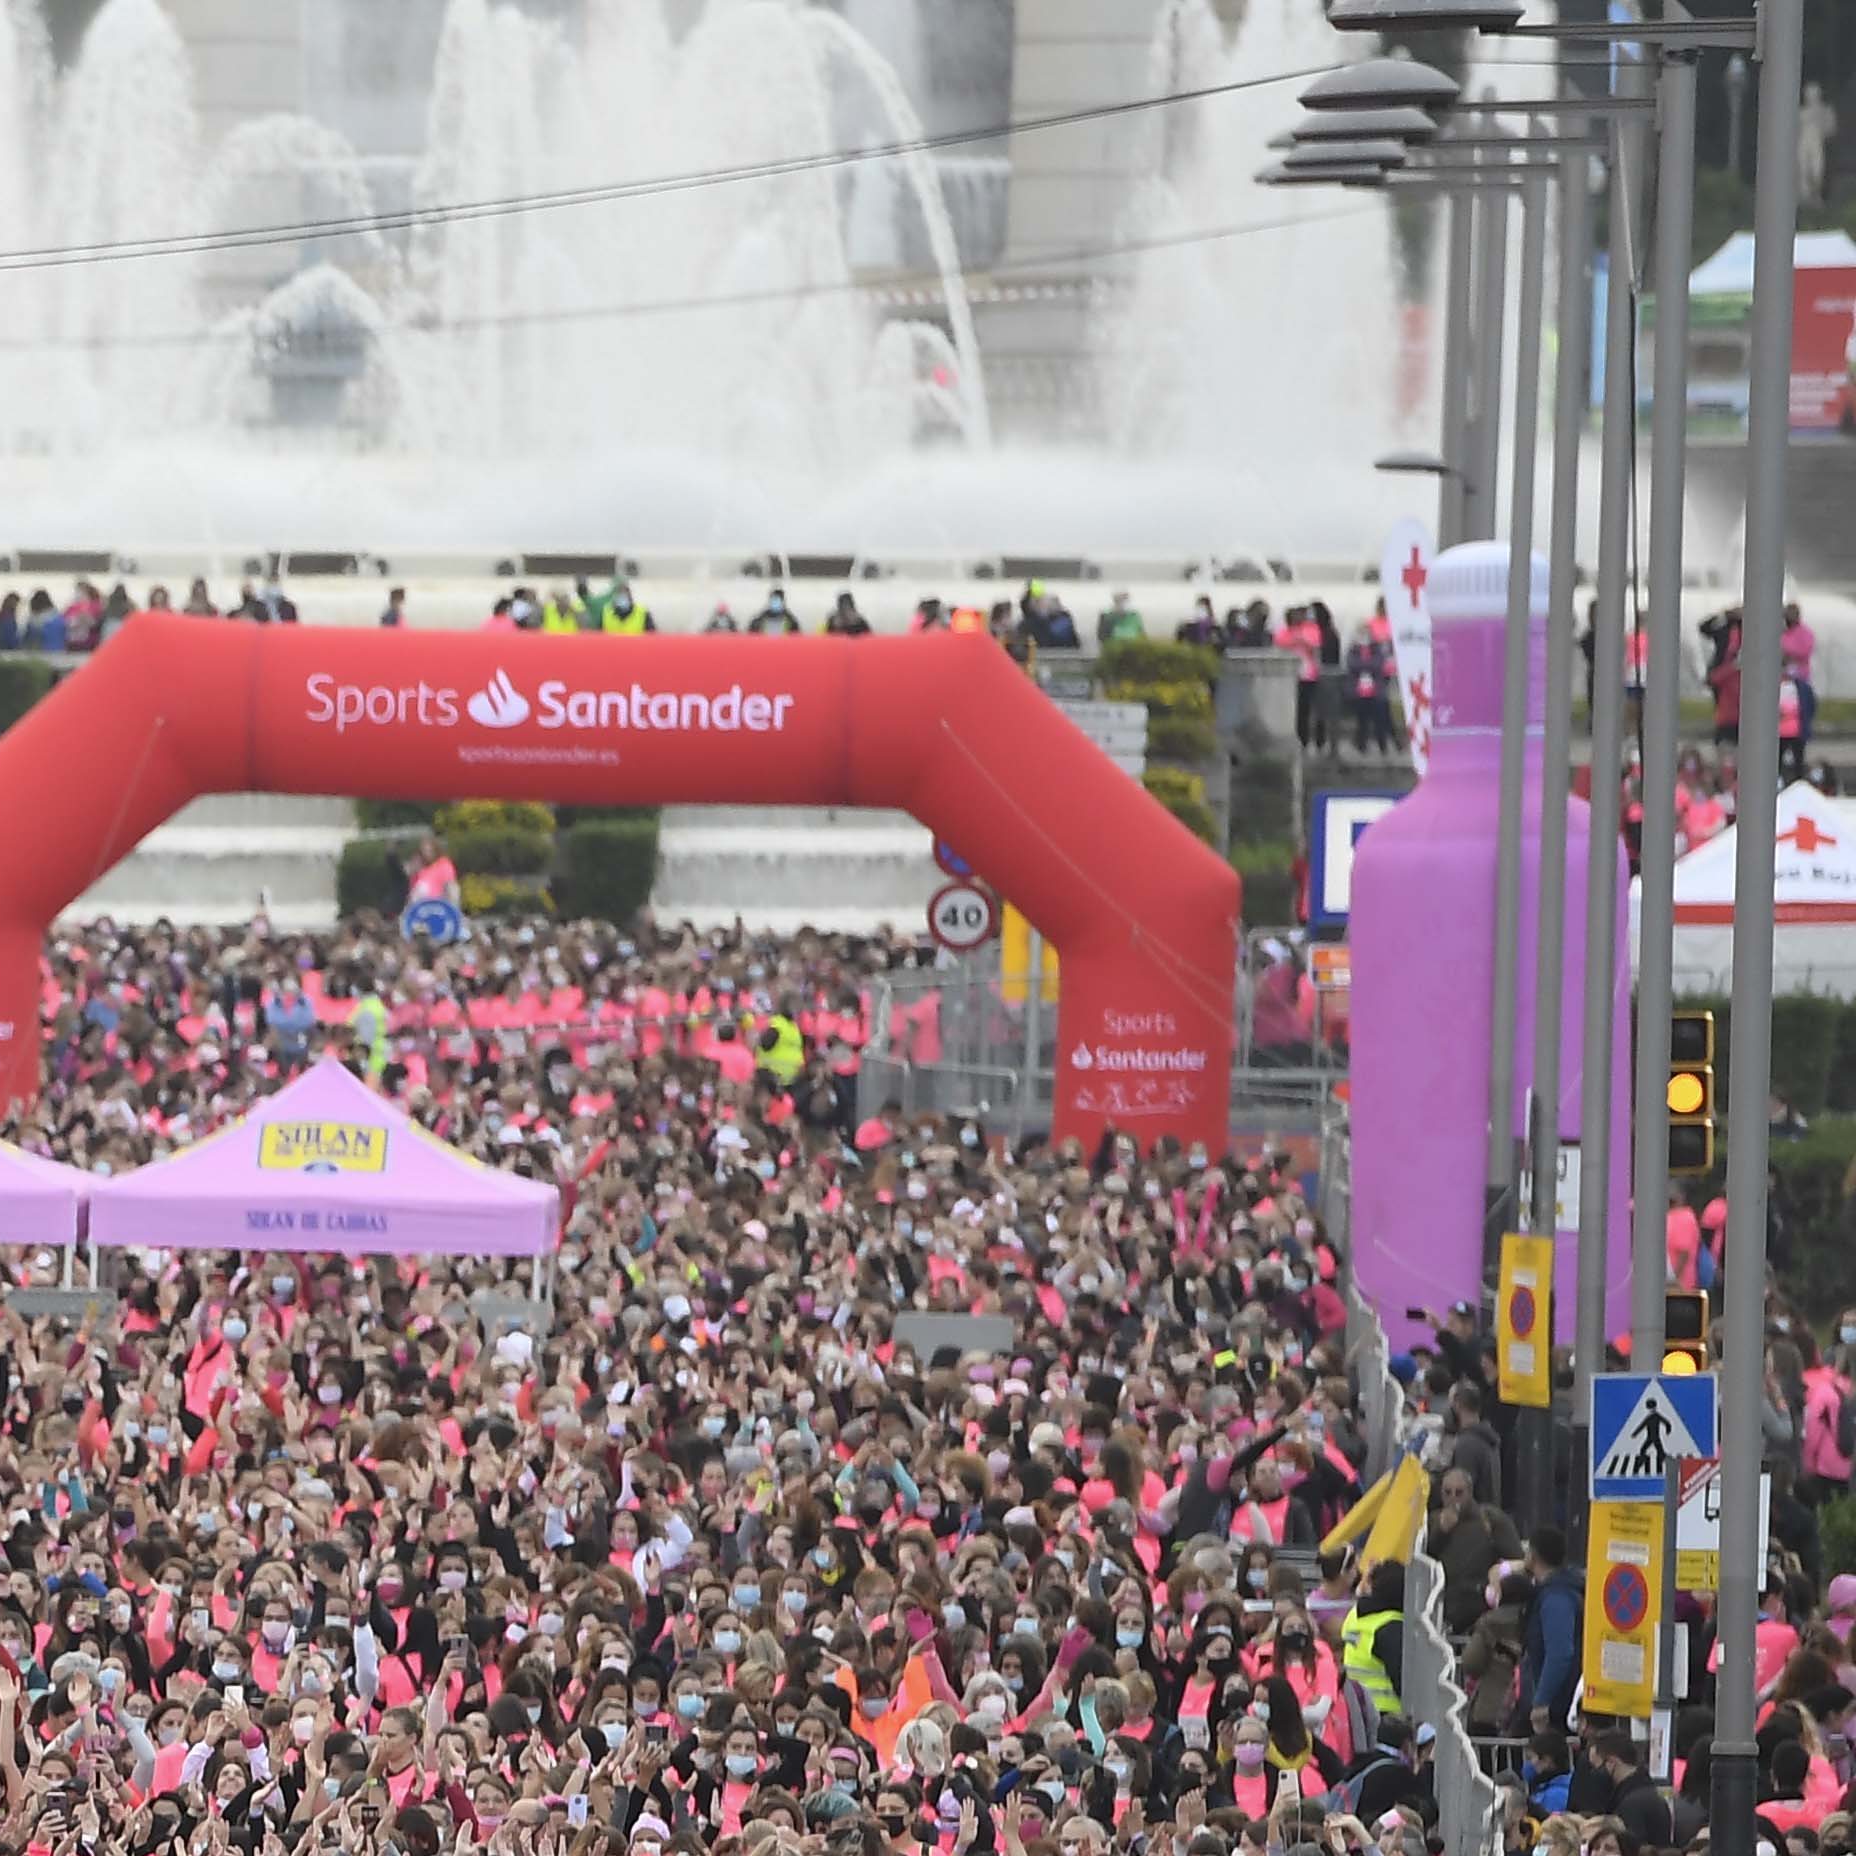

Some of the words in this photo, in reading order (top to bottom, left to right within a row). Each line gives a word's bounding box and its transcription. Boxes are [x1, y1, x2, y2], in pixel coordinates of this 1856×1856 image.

[305, 672, 459, 733] Sports
[536, 680, 795, 731] Santander
[940, 903, 983, 929] 40
[1103, 1008, 1177, 1035] Sports
[1095, 1045, 1208, 1071] Santander
